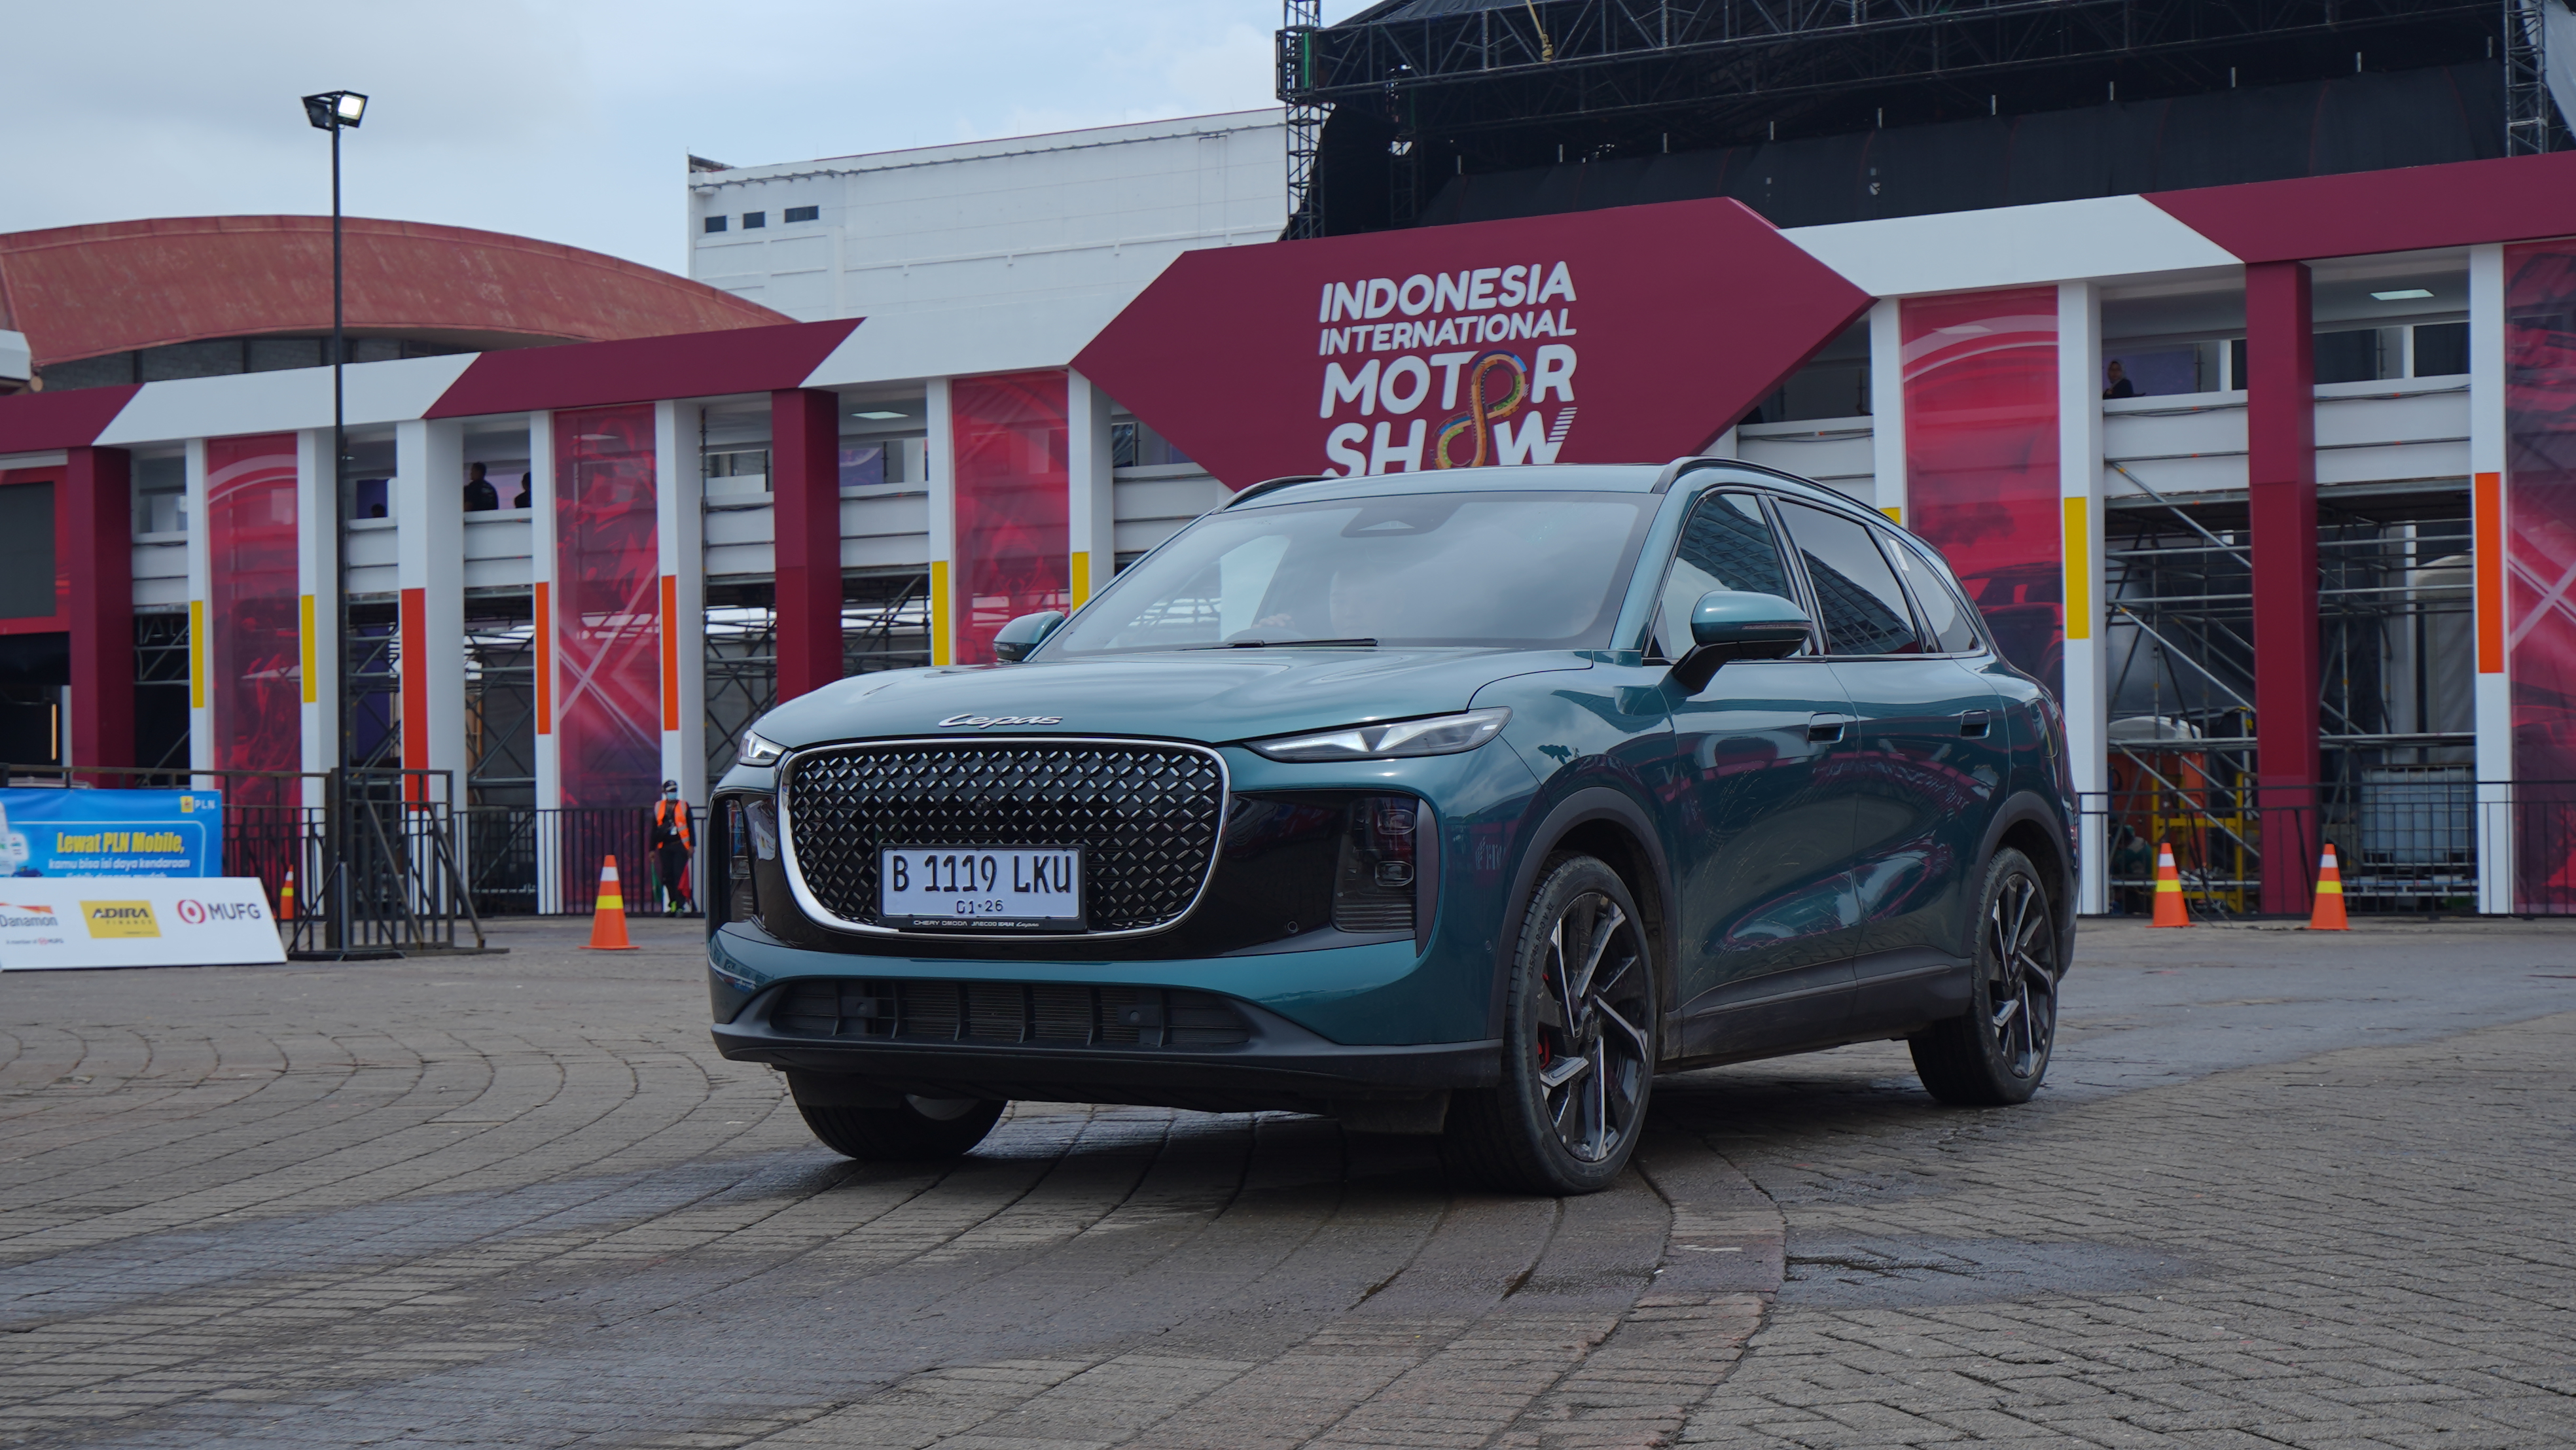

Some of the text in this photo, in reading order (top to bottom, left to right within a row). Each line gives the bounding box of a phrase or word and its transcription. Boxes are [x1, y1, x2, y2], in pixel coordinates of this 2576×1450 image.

[1319, 260, 1577, 323] INDONESIA
[1319, 308, 1577, 355] INTERNATIONAL
[1319, 344, 1577, 419] MOTOR
[939, 713, 1064, 729] Lepas
[194, 800, 215, 809] PLN
[57, 832, 185, 854] Lewat PLN Mobile,
[48, 857, 190, 872] kamu bisa isi daya kendaraan
[893, 855, 1071, 893] B 1119 LKU
[0, 914, 58, 927] Danamon
[92, 907, 149, 919] ADIRA
[207, 903, 261, 920] MUFG
[1528, 943, 1539, 980] 235/45
[1535, 921, 1545, 942] R20
